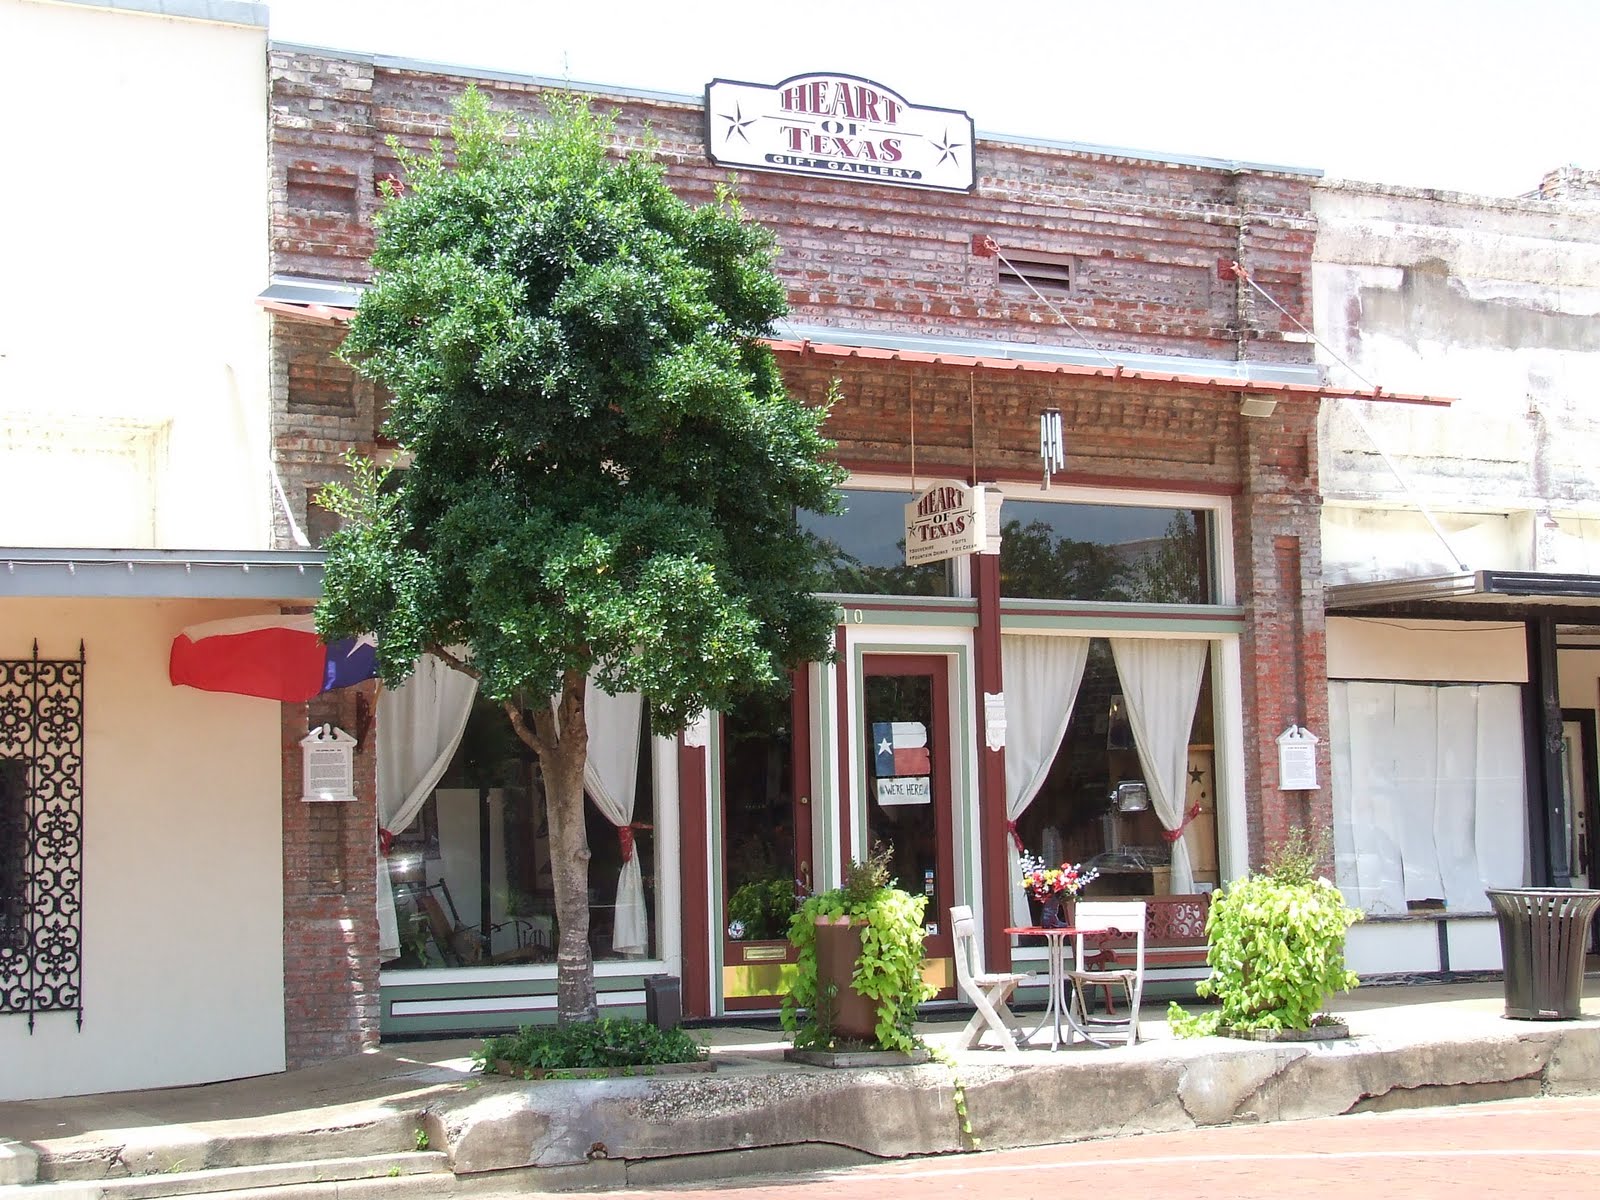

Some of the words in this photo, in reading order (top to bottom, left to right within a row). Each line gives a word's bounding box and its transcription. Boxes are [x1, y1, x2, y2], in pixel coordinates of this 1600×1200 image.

[780, 81, 902, 125] HEART
[821, 120, 865, 136] OF
[780, 126, 902, 163] TEXAS
[773, 155, 817, 168] GIFT
[828, 161, 916, 179] GALLERY
[917, 486, 965, 517] HEART
[918, 516, 966, 542] TEXAS
[933, 512, 950, 524] OF
[885, 783, 904, 796] WE'RE
[906, 783, 923, 796] HERE
